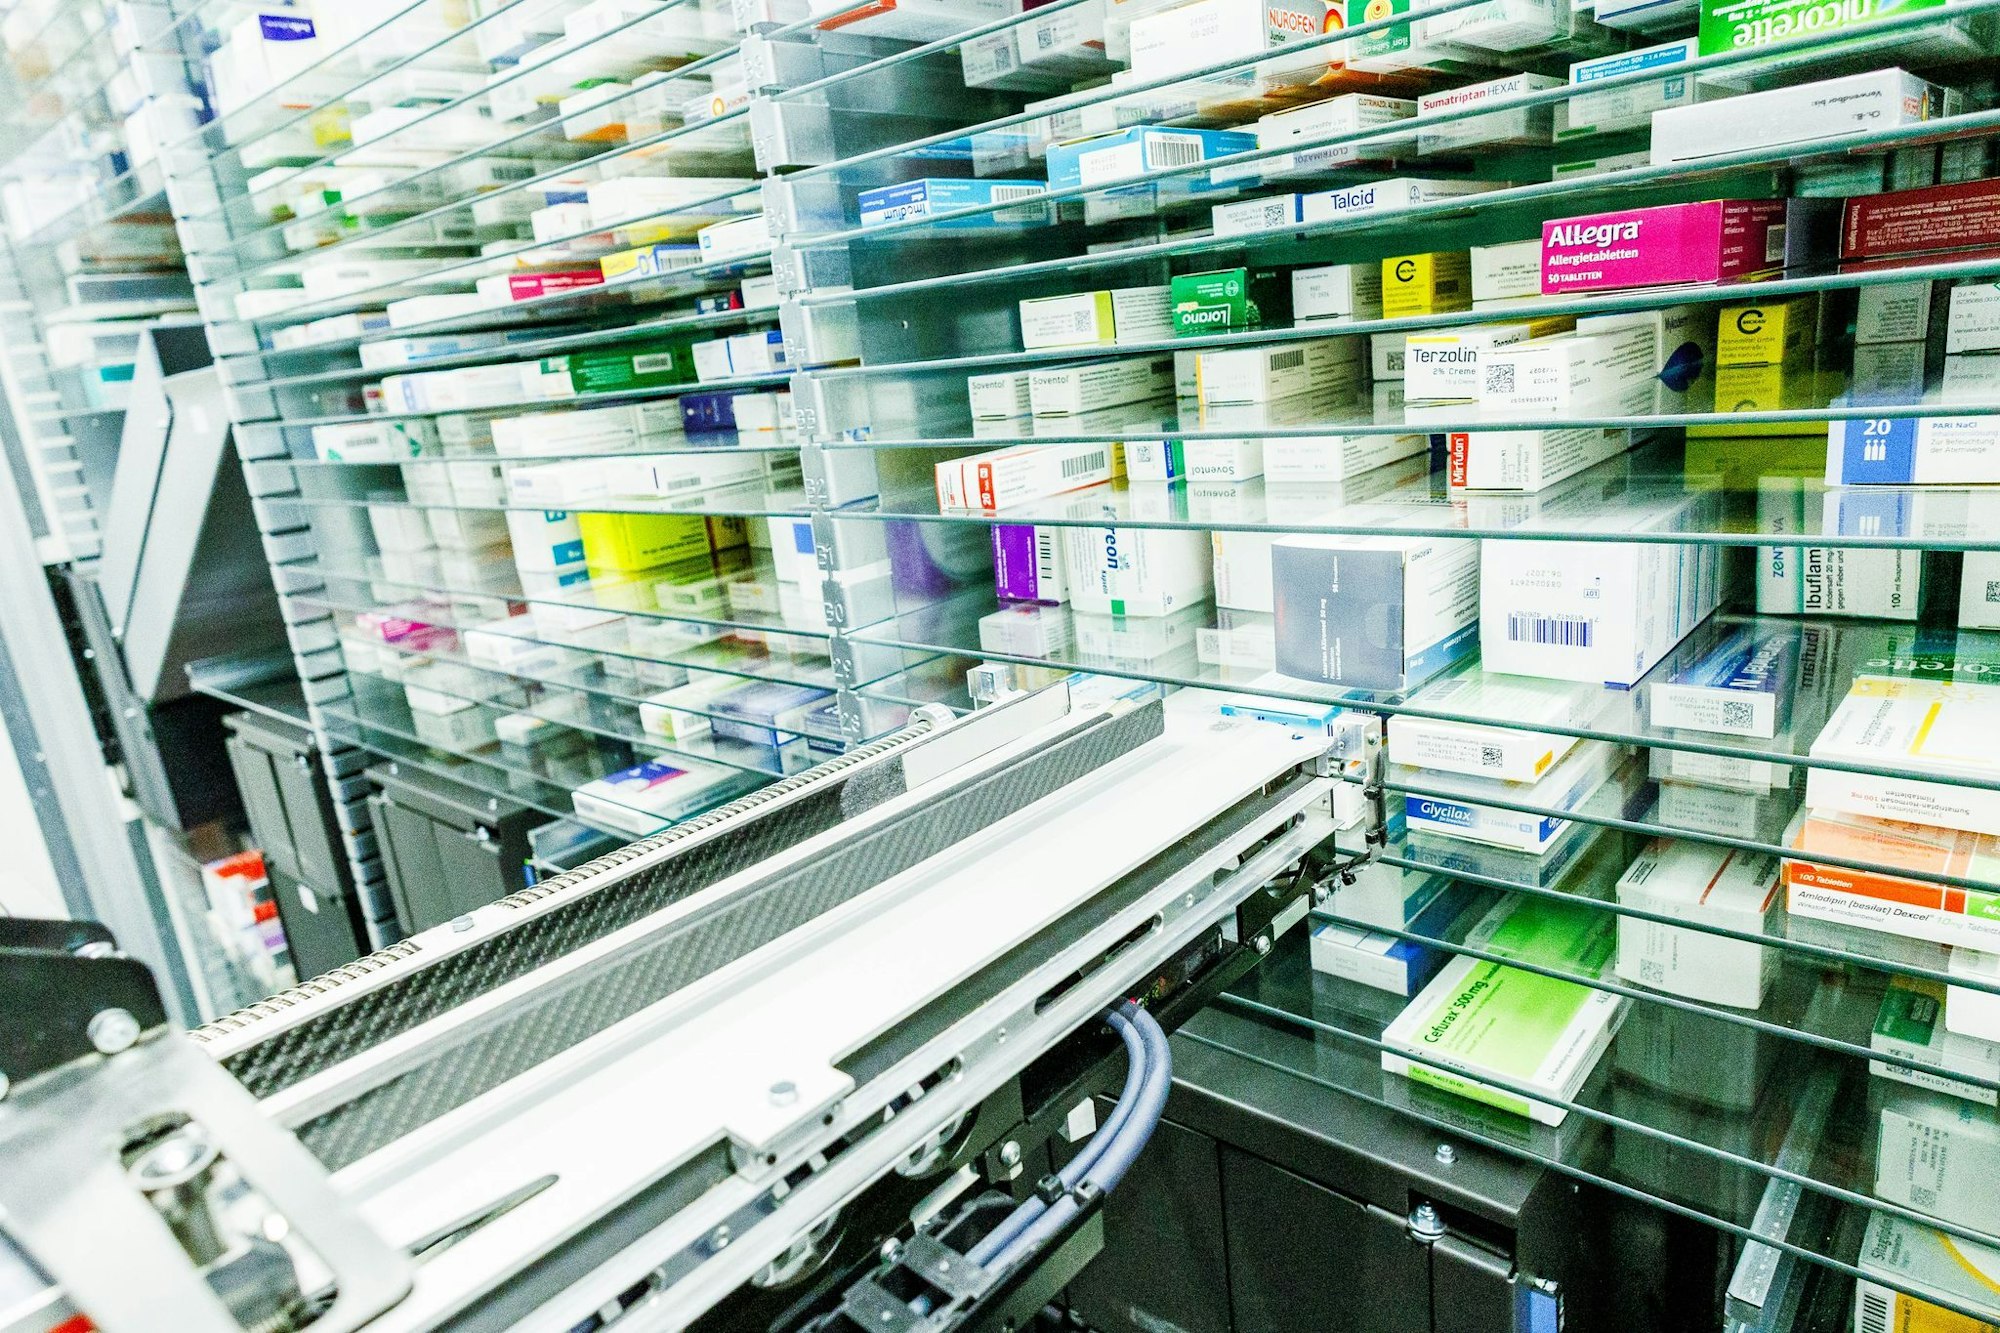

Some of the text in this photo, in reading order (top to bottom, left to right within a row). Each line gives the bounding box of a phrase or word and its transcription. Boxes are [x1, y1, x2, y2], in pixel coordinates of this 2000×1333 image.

[1269, 7, 1317, 33] NUROFEN
[1733, 0, 1873, 47] nicorette
[1270, 32, 1286, 43] Junior
[1423, 79, 1520, 111] Sumatriptan HEXAL
[1331, 190, 1374, 210] Talcid
[884, 203, 926, 222] Imodium
[1547, 220, 1640, 249] Allegra
[1548, 247, 1639, 266] Allergietabletten
[1548, 273, 1560, 284] 50
[1560, 271, 1602, 283] TABLETTEN
[1182, 309, 1229, 325] Lorano
[1413, 347, 1477, 364] Terzolin
[1032, 375, 1070, 386] Soventol
[1432, 367, 1477, 376] 2% Creme
[972, 380, 1005, 391] Soventol
[1863, 419, 1892, 436] 20
[1932, 422, 1953, 430] PARI
[1191, 465, 1235, 476] Soventol
[1453, 438, 1465, 485] Mirfulan
[982, 493, 991, 507] 20
[816, 545, 834, 566] 31
[1827, 564, 1834, 573] 20
[1806, 549, 1822, 609] Ibuflam
[1837, 588, 1846, 610] gegen
[1891, 593, 1901, 608] 100
[825, 602, 843, 622] 30
[833, 658, 851, 678] 29
[841, 713, 860, 732] 28
[1864, 795, 1878, 803] 100
[1885, 790, 1936, 803] Filmtabletten
[1420, 802, 1471, 822] Glycilax
[1881, 797, 1970, 816] Sumatriptan-Hormosan
[1799, 872, 1853, 888] 100 Tabletten
[1798, 890, 1847, 906] Amlodipin
[1893, 908, 1931, 921] Dexcel
[1424, 980, 1488, 1043] Cefurax 500 mg
